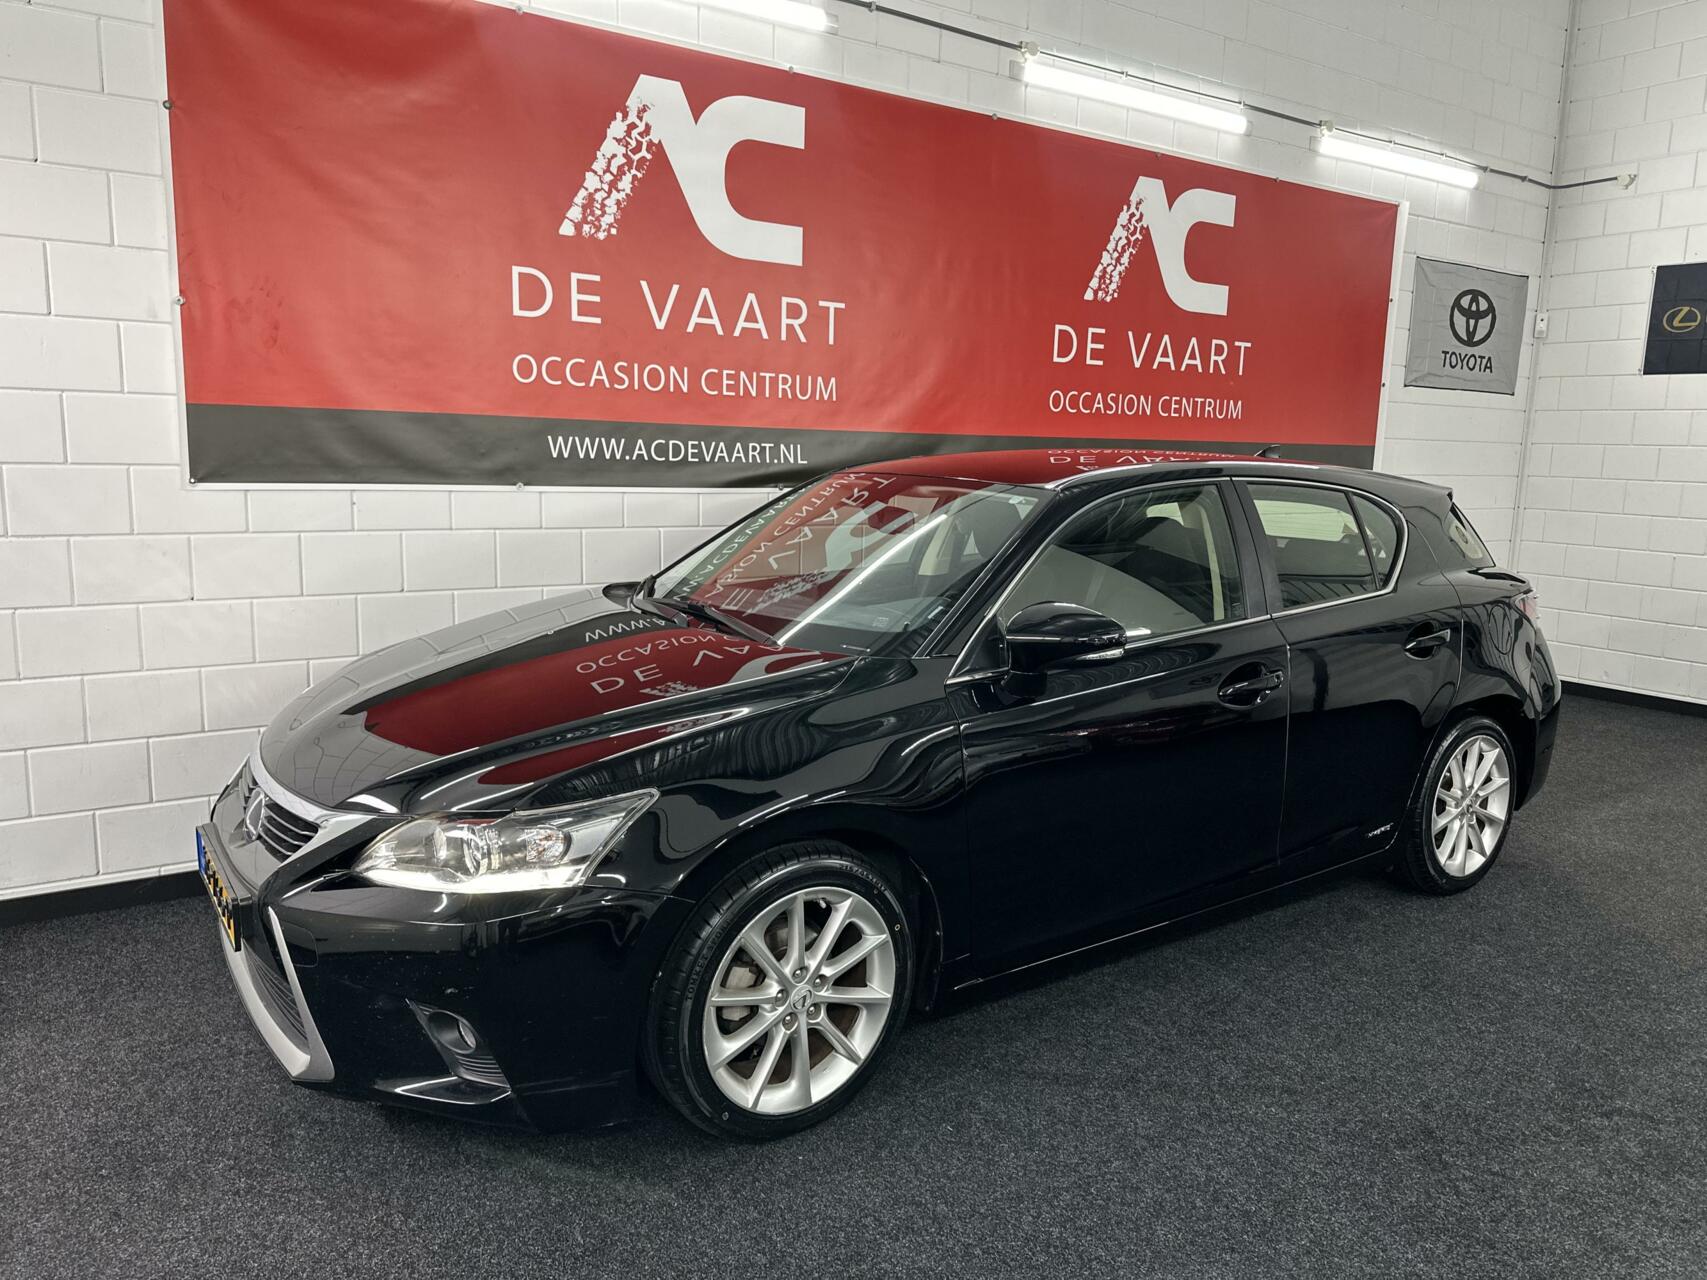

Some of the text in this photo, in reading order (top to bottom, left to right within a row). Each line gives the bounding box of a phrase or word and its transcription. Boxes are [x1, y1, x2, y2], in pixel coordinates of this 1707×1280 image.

[558, 73, 806, 267] AC
[1083, 175, 1237, 316] AC
[511, 264, 846, 346] DE VAART
[1052, 323, 1252, 376] DE VAART
[1441, 350, 1493, 374] TOYOTA
[511, 353, 838, 402] OCCASION CENTRUM
[1049, 389, 1243, 420] OCCASION CENTRUM
[547, 434, 808, 464] WWW.ACDEVAART.NL
